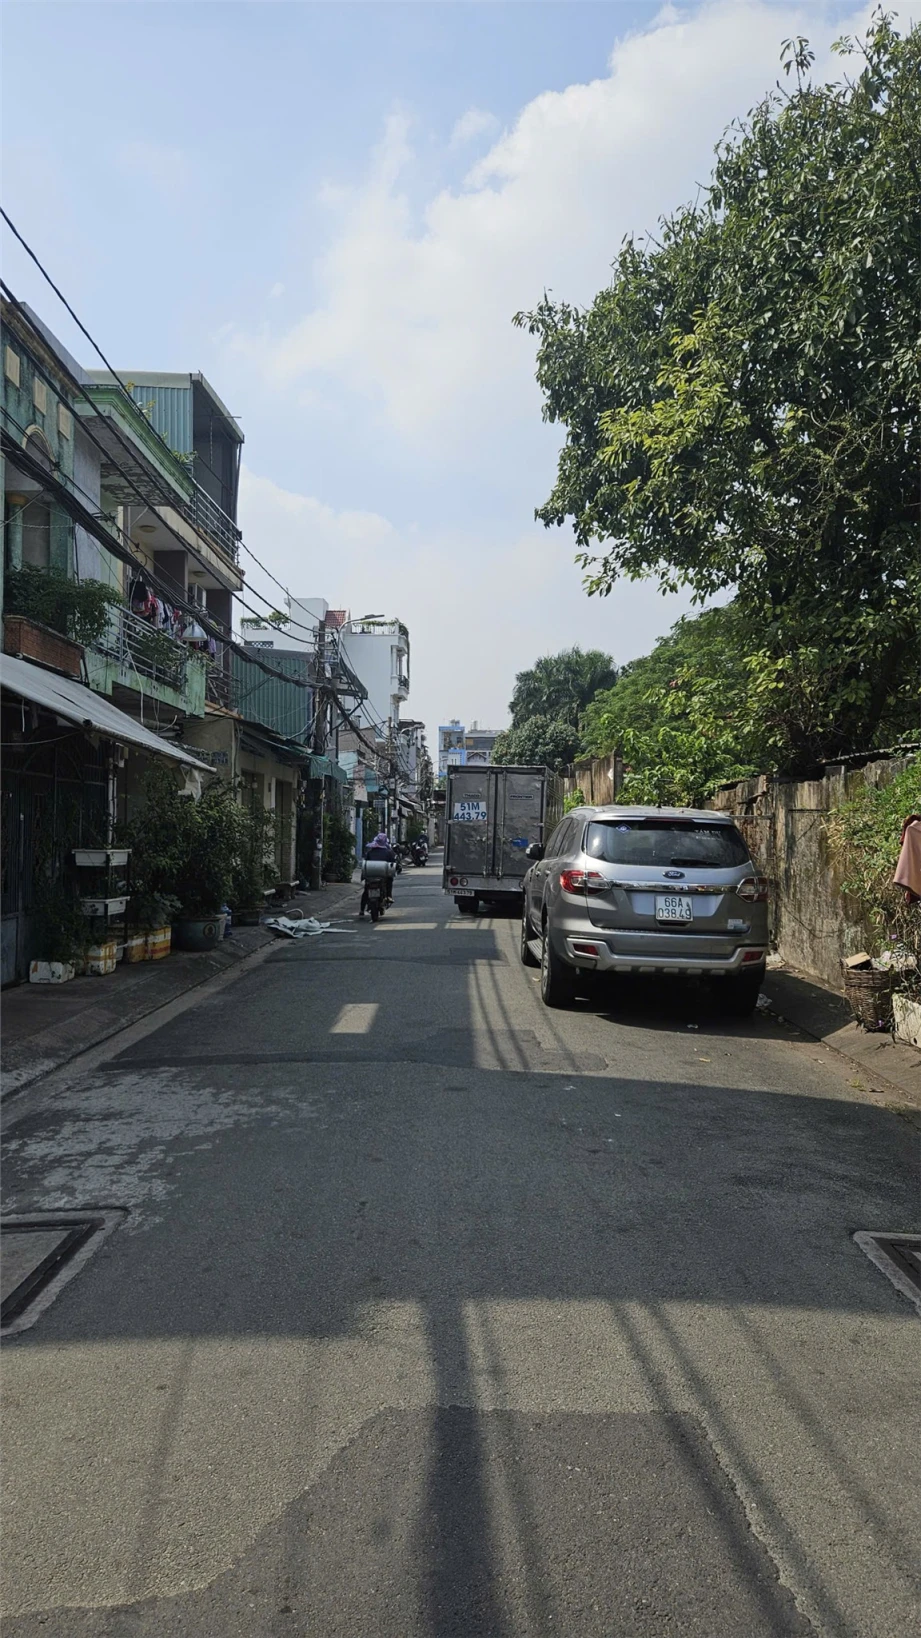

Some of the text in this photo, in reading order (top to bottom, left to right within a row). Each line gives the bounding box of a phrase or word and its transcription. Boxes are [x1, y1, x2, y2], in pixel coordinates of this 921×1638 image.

[460, 802, 480, 811] 51M
[454, 811, 487, 820] 443.79
[664, 897, 684, 908] 66A
[657, 908, 692, 920] 038.49
